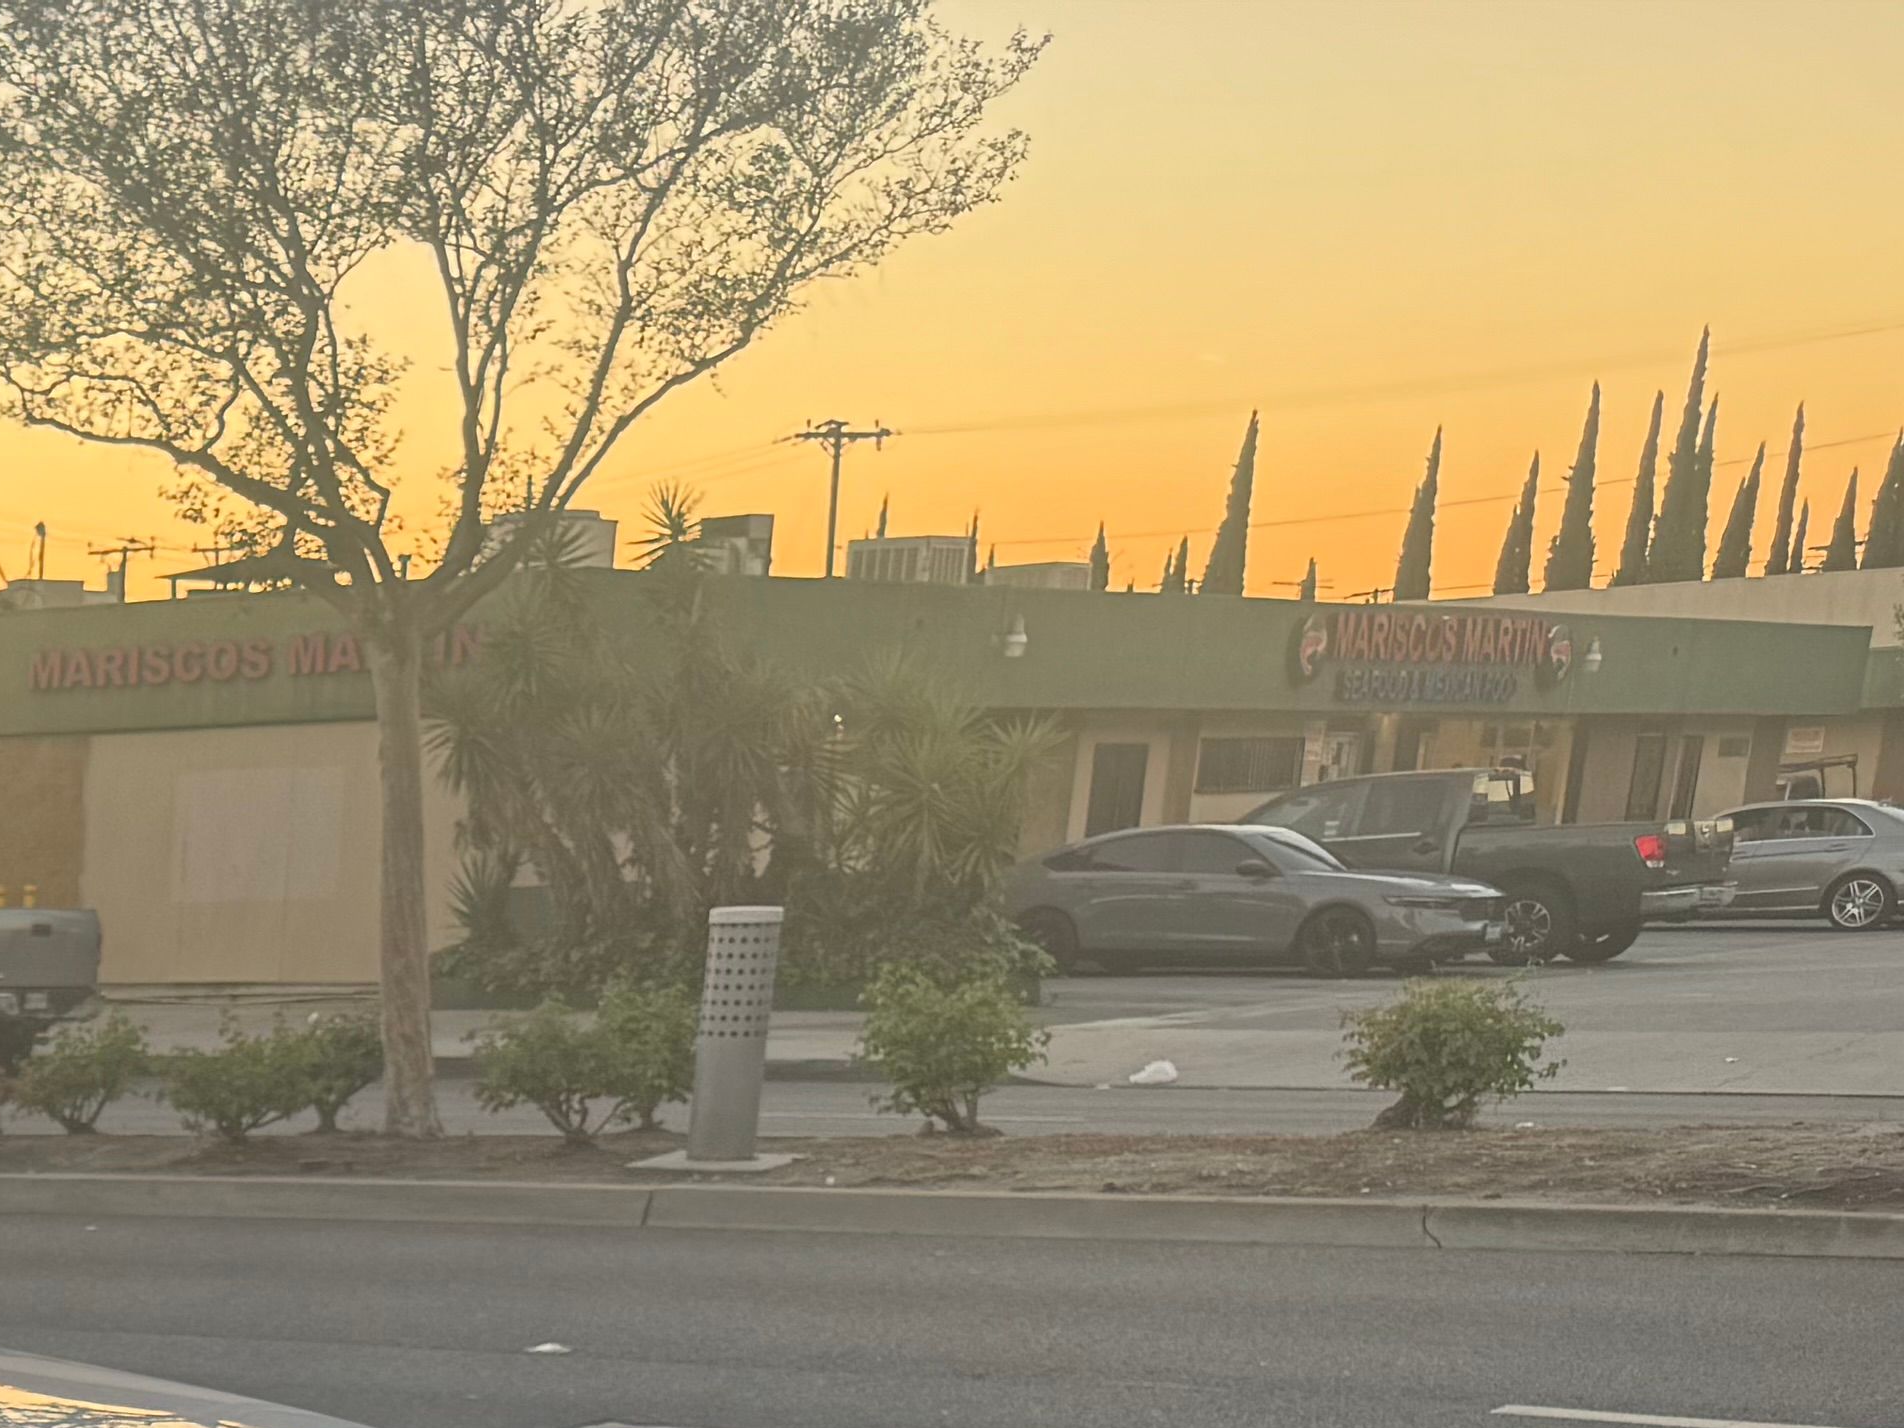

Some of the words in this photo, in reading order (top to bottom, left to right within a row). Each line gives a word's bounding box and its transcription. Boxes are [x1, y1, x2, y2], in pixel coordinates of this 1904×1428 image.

[28, 638, 272, 691] MARISCOS
[287, 624, 487, 675] MAIN
[1334, 611, 1457, 664] MARISCOS
[1461, 614, 1550, 666] MARTIN
